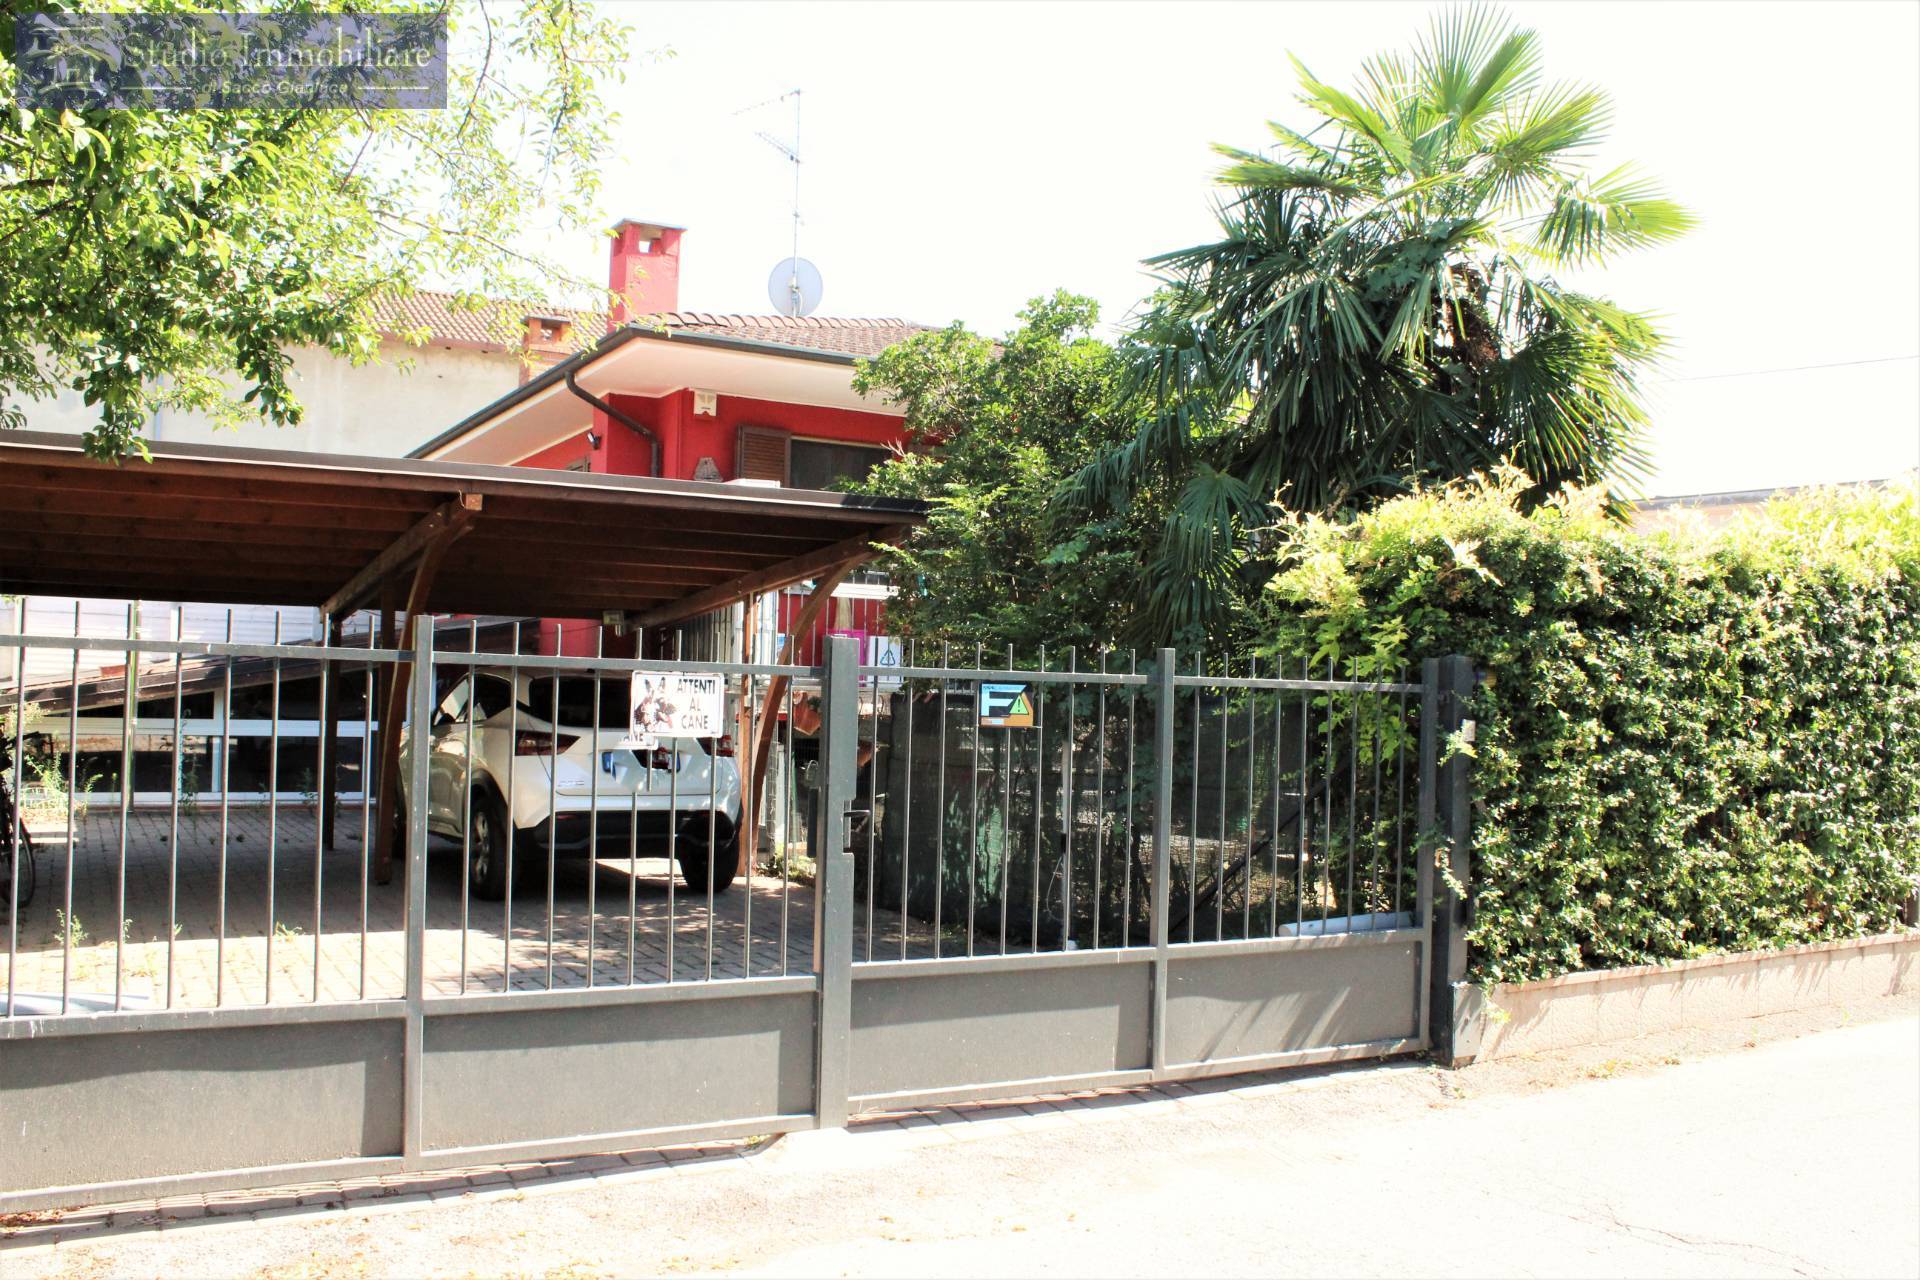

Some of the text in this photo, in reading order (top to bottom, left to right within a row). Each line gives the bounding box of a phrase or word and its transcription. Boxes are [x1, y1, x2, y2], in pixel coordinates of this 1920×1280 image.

[677, 678, 716, 694] ATTENTI
[689, 697, 701, 711] AL
[681, 714, 709, 730] CANE
